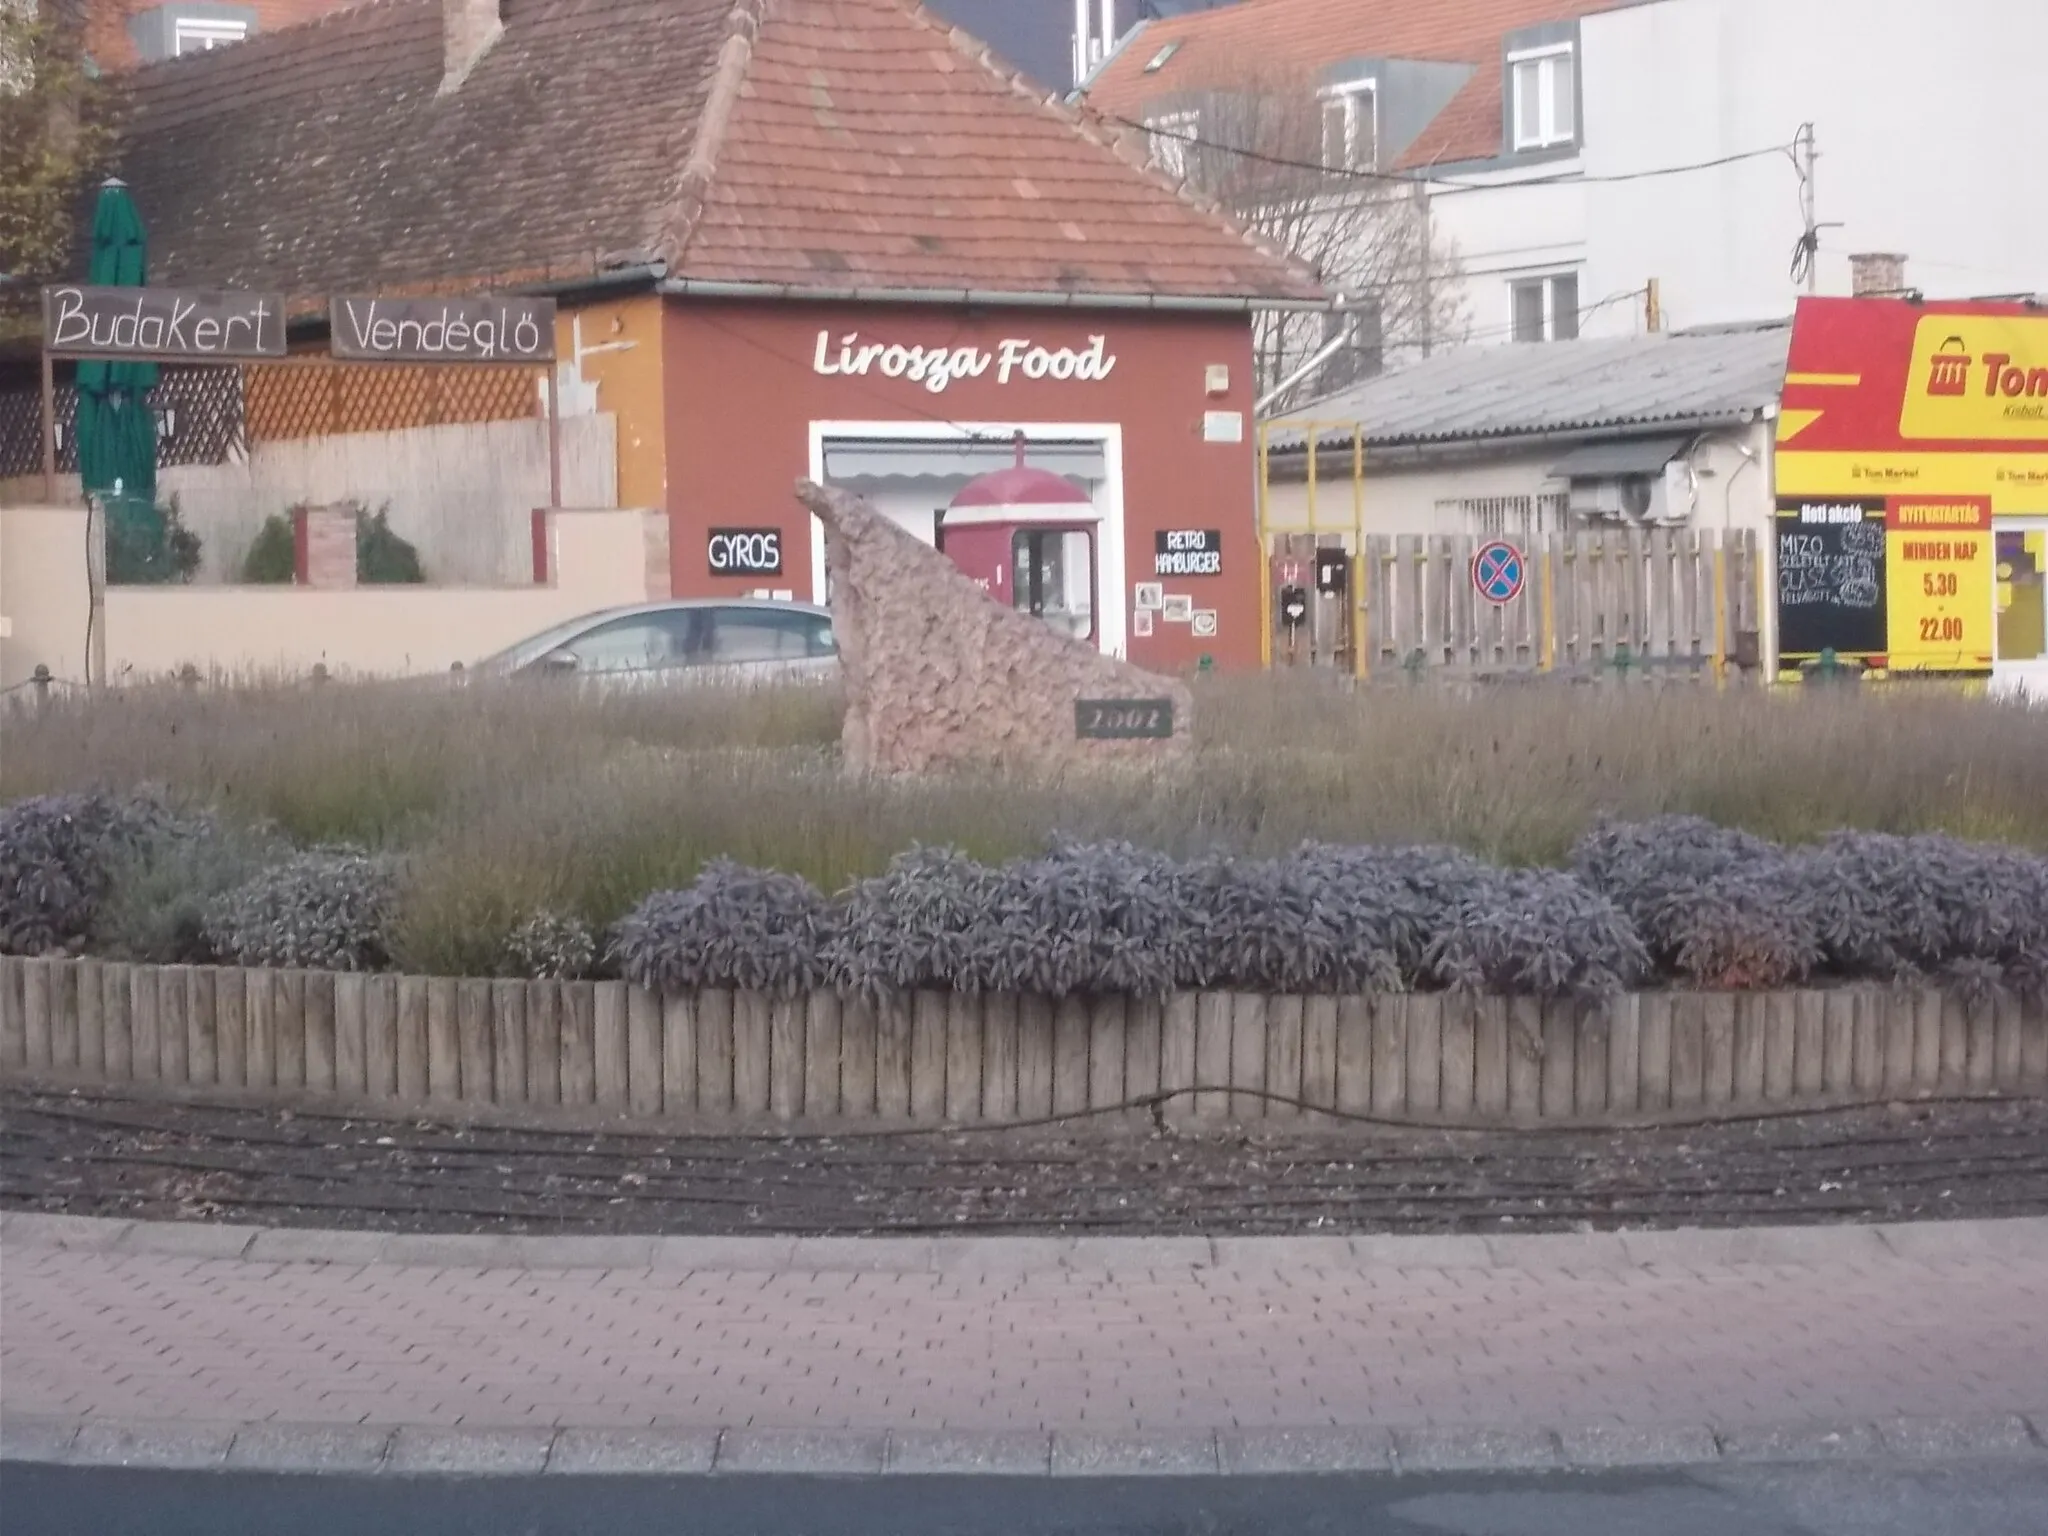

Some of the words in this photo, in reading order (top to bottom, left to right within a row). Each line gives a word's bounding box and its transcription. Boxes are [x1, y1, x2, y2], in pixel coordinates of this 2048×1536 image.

[813, 330, 991, 393] Lírosza
[997, 334, 1116, 384] Food
[1864, 467, 1883, 479] Tom
[1828, 503, 1863, 524] akció
[708, 533, 779, 568] GYROS
[1167, 530, 1205, 549] RETRO
[1155, 551, 1221, 574] HAMBURGER
[1902, 541, 1951, 562] MINDEN
[1954, 541, 1978, 561] NAP
[1923, 571, 1957, 597] 5.30
[1919, 617, 1963, 641] 22.00
